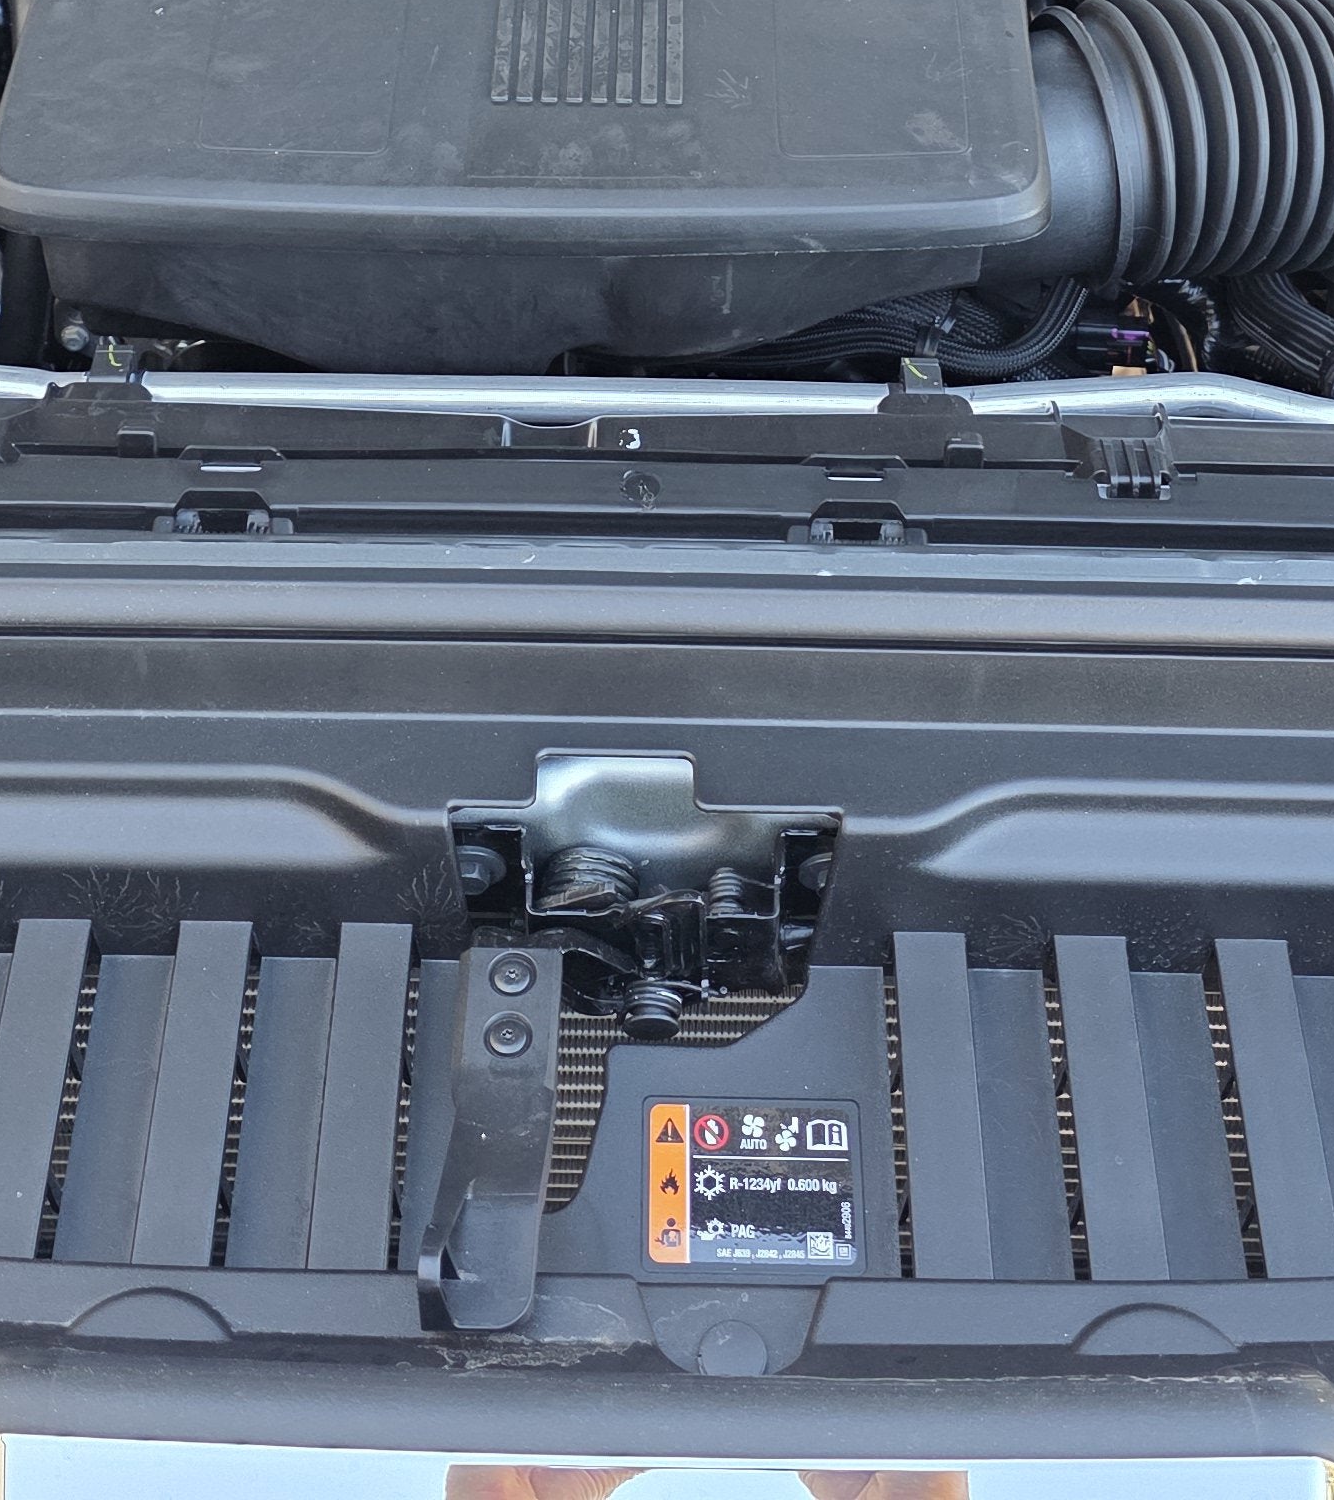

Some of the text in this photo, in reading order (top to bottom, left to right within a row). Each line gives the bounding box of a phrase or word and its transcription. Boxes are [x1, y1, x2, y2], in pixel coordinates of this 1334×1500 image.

[739, 1139, 767, 1150] AUTO
[729, 1177, 781, 1193] R-1234yf
[822, 1179, 838, 1194] kg
[731, 1224, 756, 1238] PAG
[716, 1248, 732, 1258] SAE
